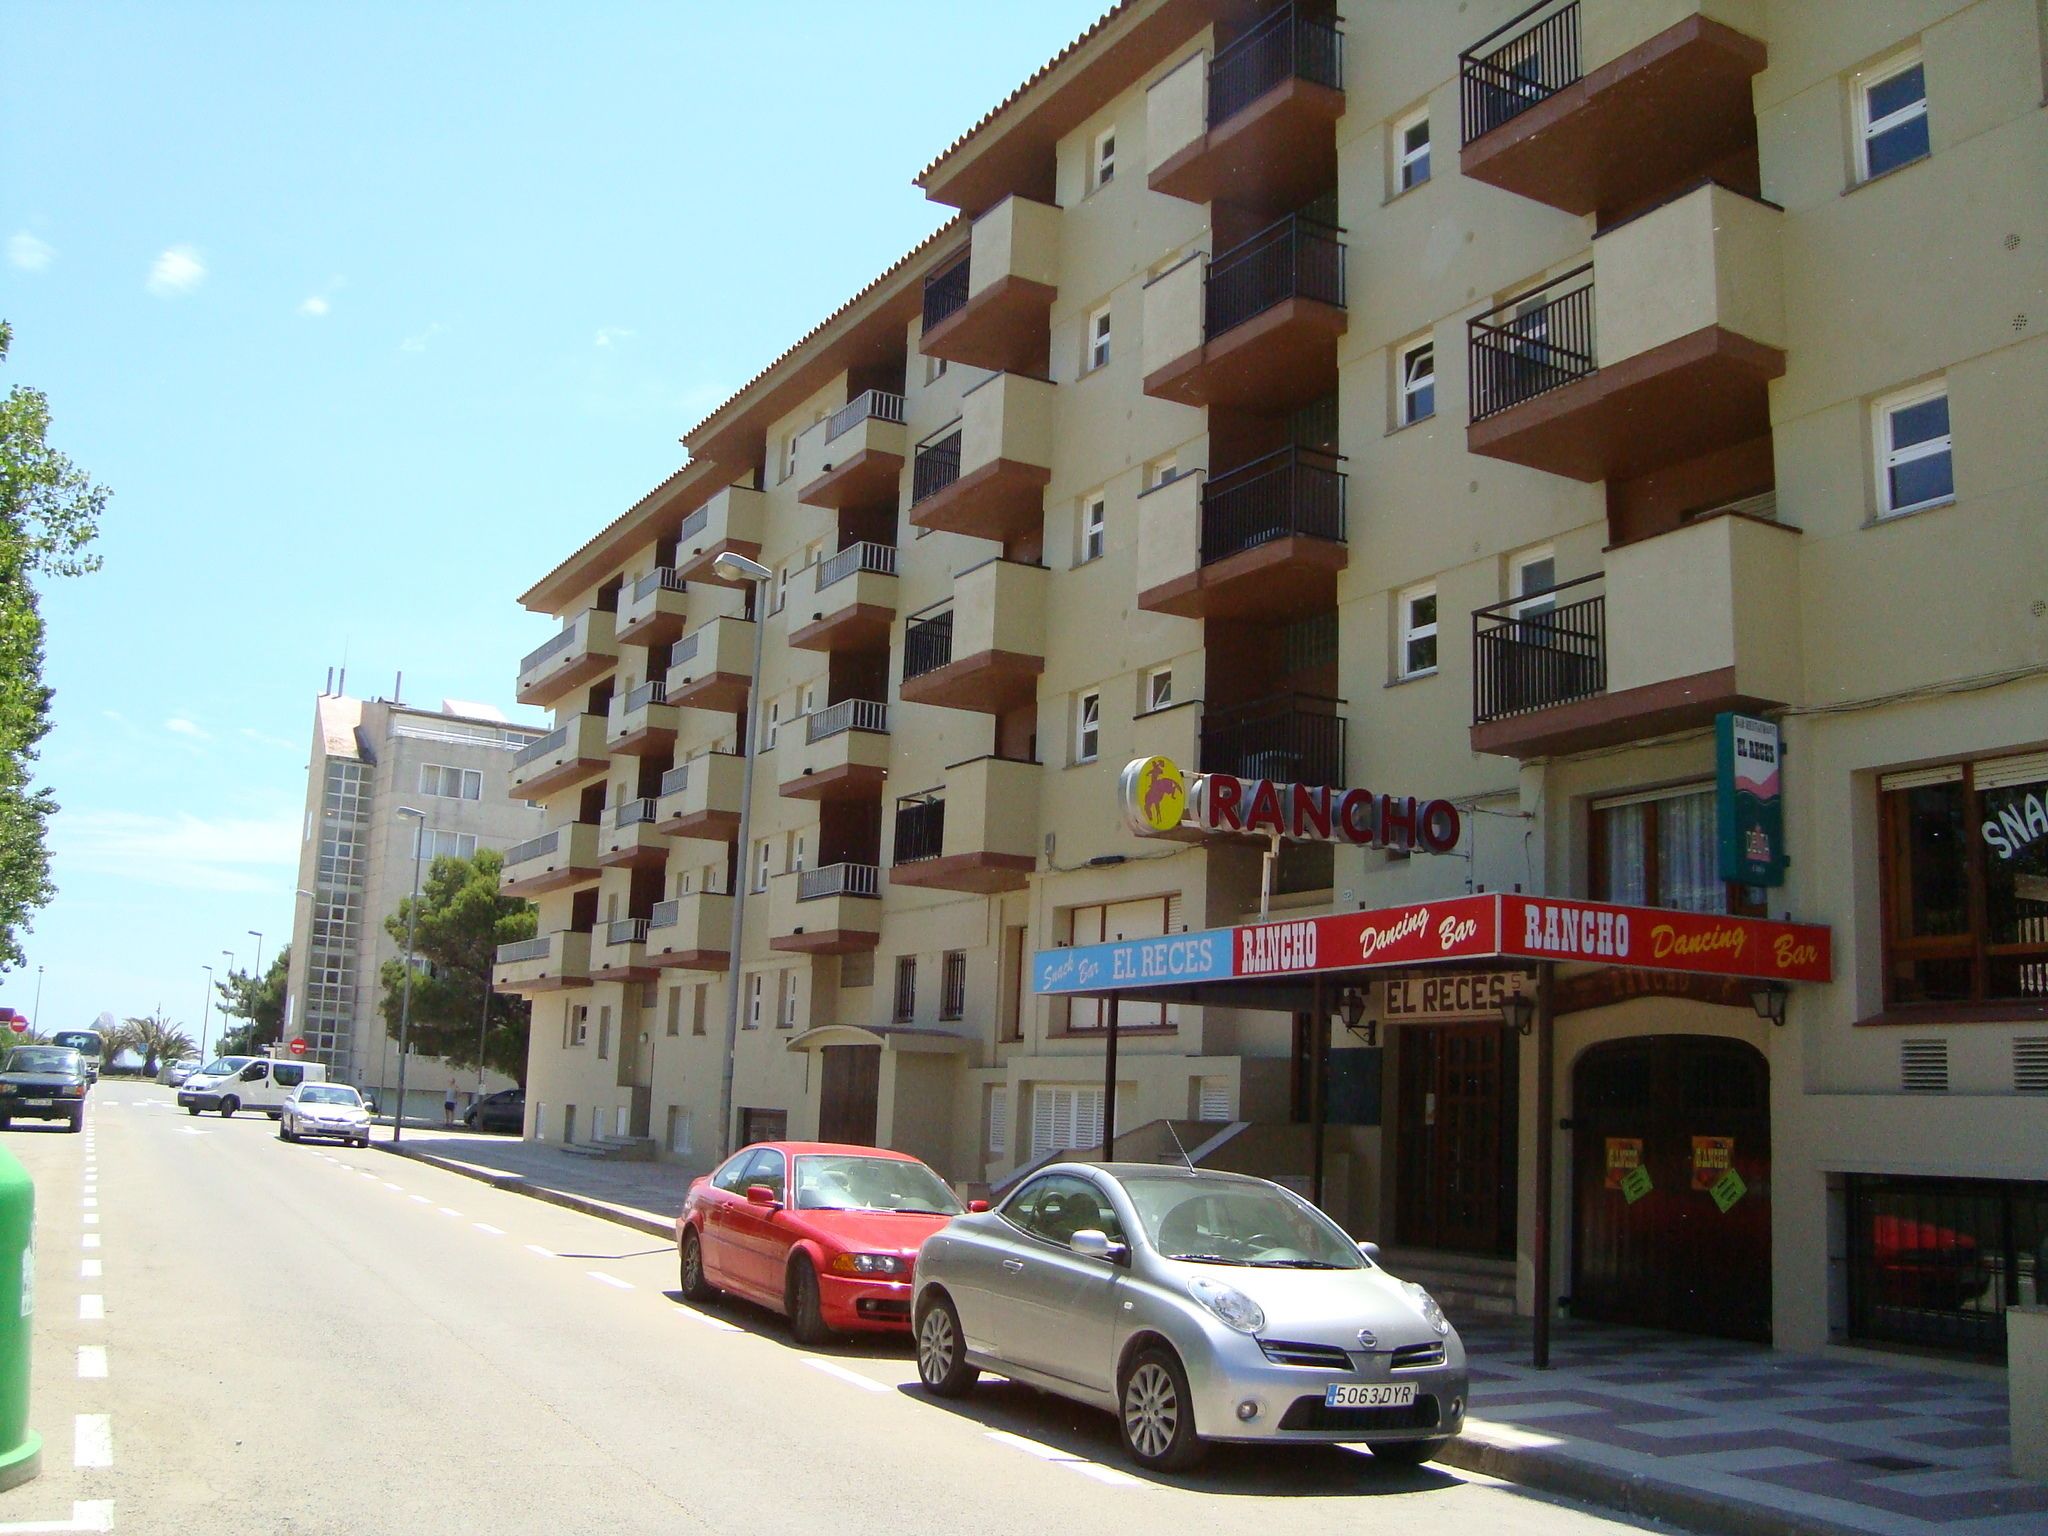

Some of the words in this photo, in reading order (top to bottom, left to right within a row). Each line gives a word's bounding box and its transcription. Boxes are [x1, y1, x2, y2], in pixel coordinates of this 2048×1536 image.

[1737, 737, 1747, 757] EL
[1209, 773, 1460, 852] RANCHO
[1982, 789, 2048, 858] SNA
[1241, 920, 1317, 974] RANCHO
[1360, 908, 1430, 959] Dancing
[1438, 914, 1477, 951] Bar
[1524, 904, 1629, 957] RANCHO
[1651, 924, 1747, 959] Dancing
[1774, 934, 1818, 968] Bar
[1043, 951, 1074, 990] Snack
[1079, 958, 1099, 984] Bar
[1112, 947, 1136, 980] EL
[1141, 938, 1213, 977] RECES
[1387, 980, 1416, 1013] EL
[1422, 975, 1505, 1012] RECES
